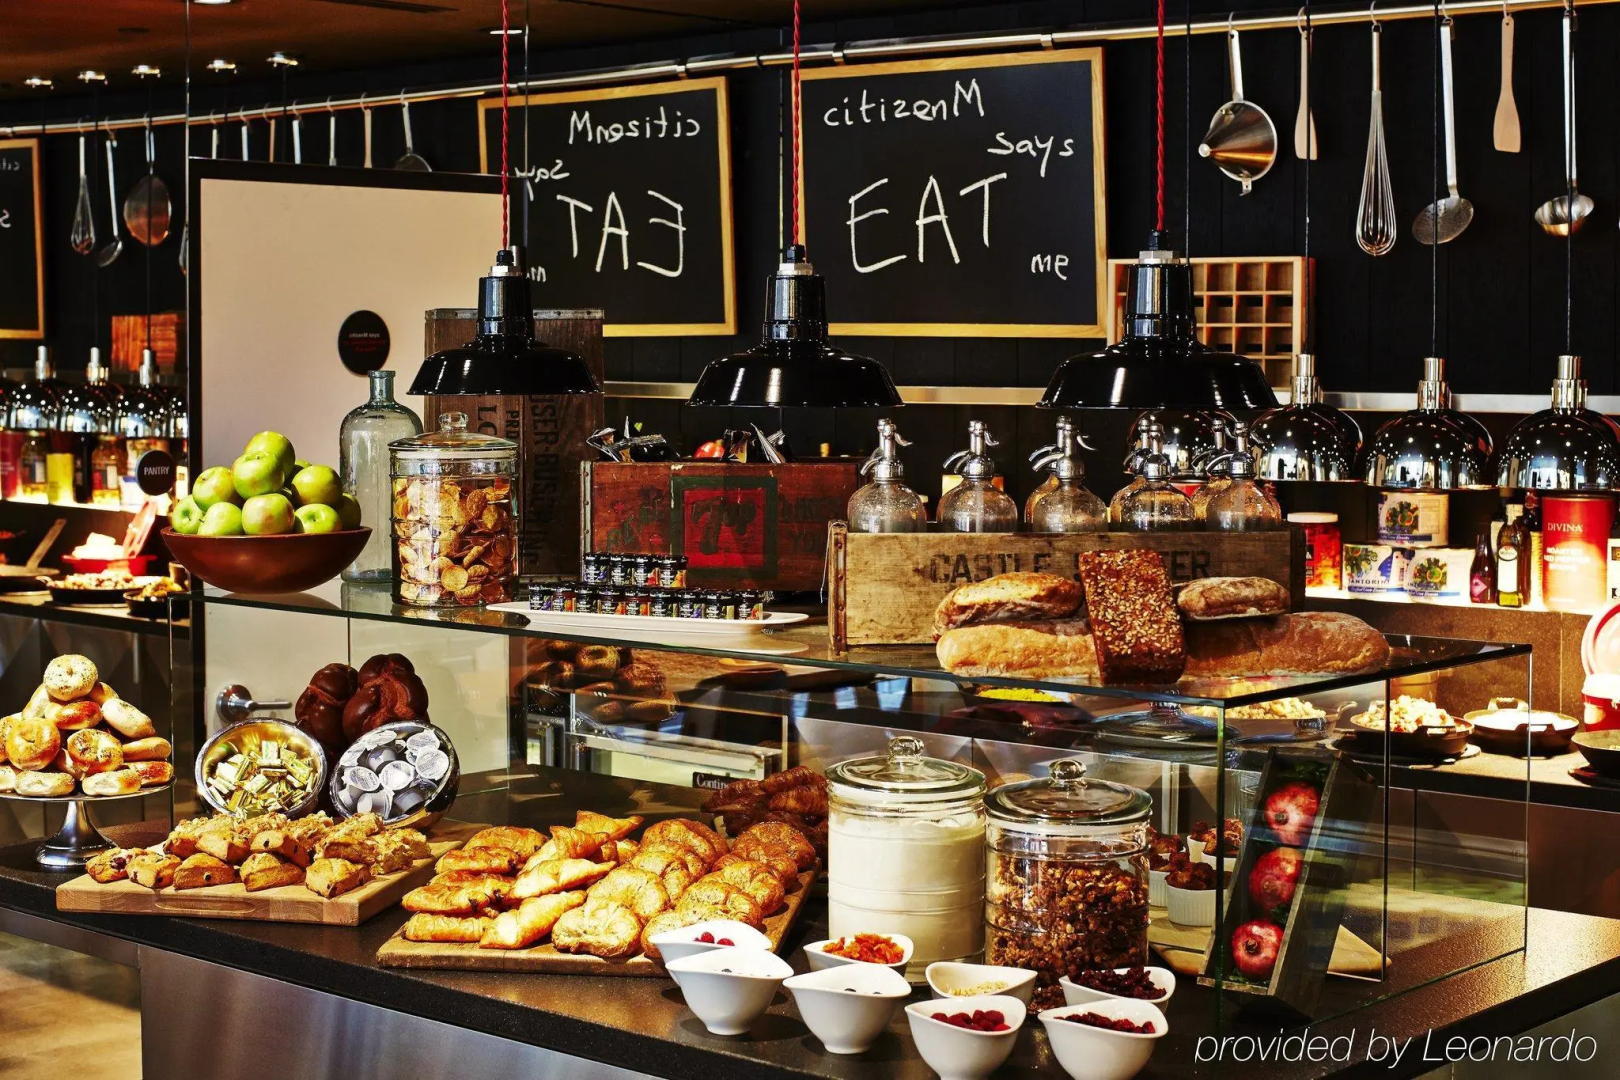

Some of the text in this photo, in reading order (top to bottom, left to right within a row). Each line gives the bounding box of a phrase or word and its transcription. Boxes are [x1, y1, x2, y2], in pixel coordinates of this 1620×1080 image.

[824, 78, 984, 126] citizenM
[987, 132, 1074, 177] Says
[846, 172, 1007, 273] EAT
[1031, 253, 1070, 280] me
[143, 466, 170, 476] PANTRY
[1547, 522, 1583, 532] DIVINA
[697, 774, 729, 789] Contin
